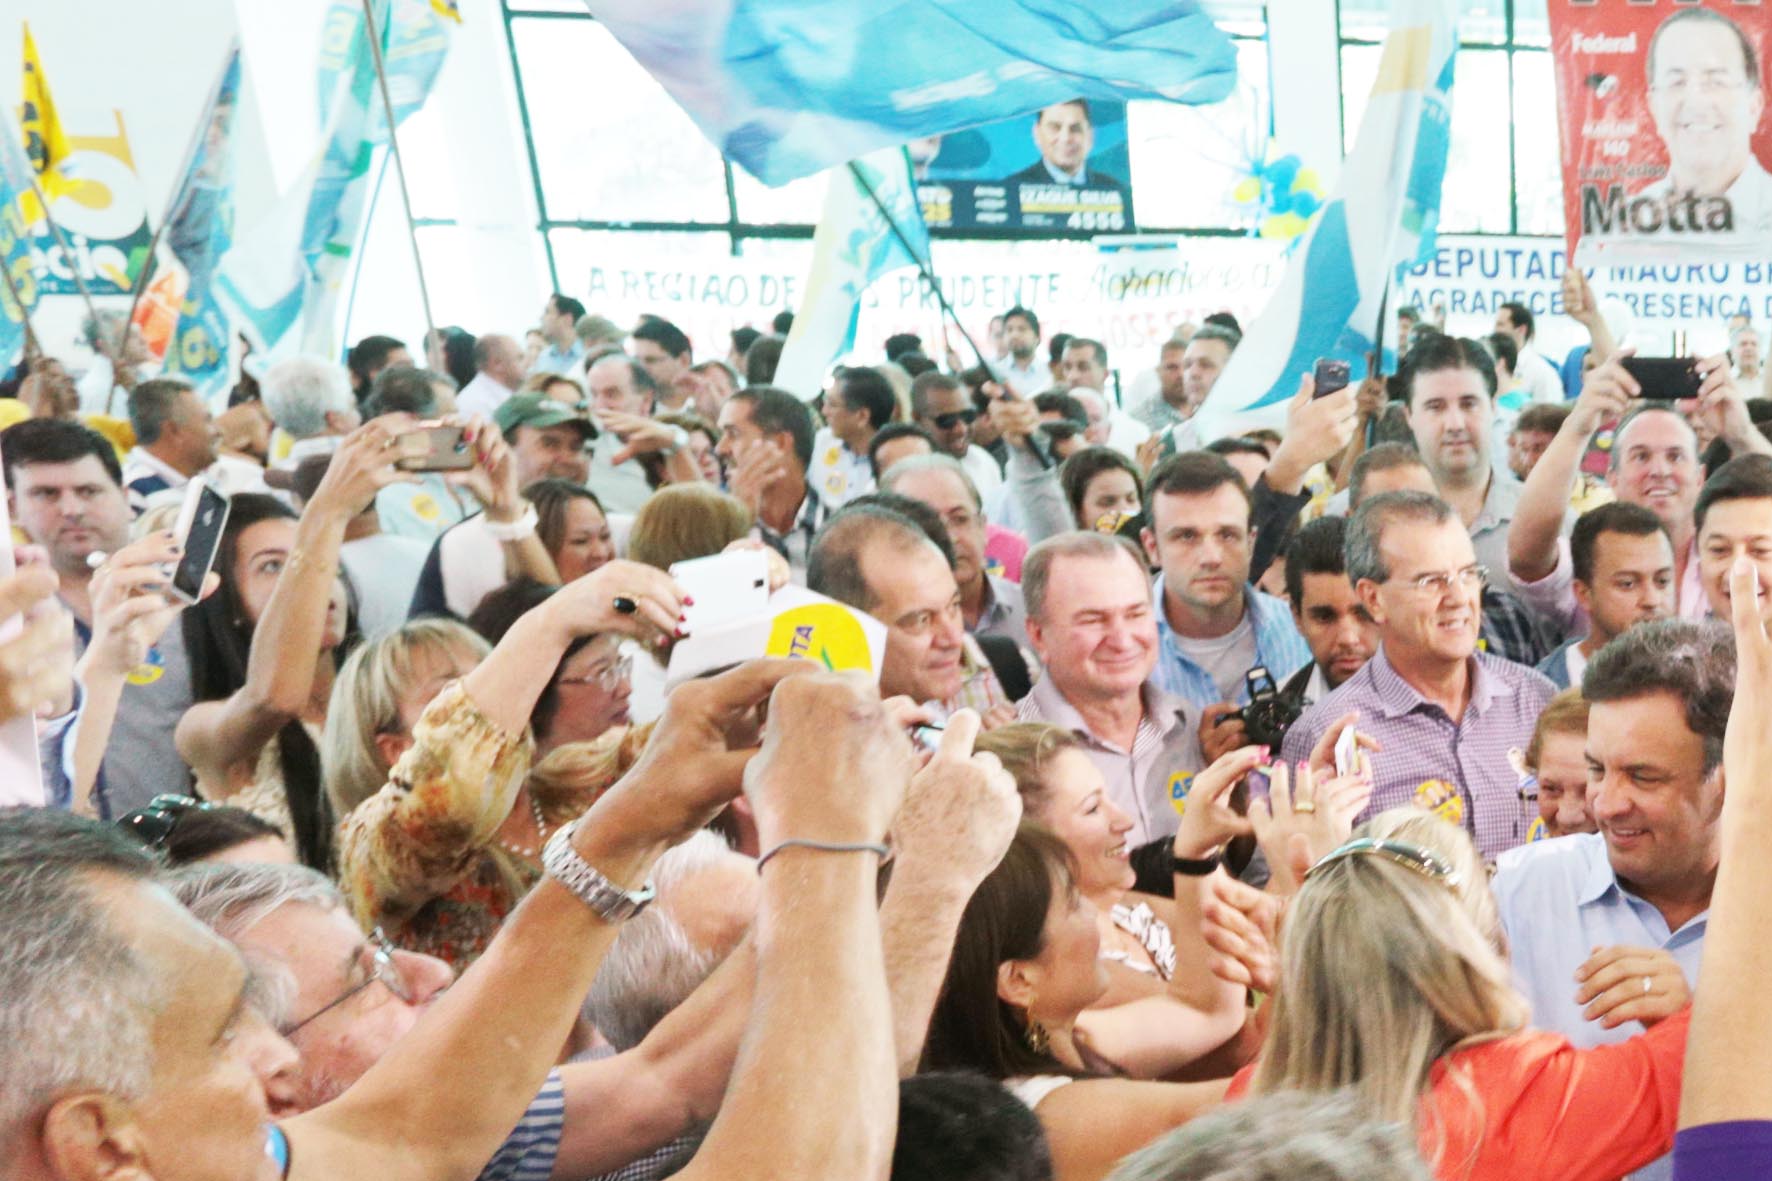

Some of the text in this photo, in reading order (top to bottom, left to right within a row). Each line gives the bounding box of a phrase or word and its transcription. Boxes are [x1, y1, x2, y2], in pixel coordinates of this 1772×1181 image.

[1571, 32, 1637, 54] Federal
[1581, 182, 1733, 235] Motta
[898, 274, 1061, 311] PRUDENTE
